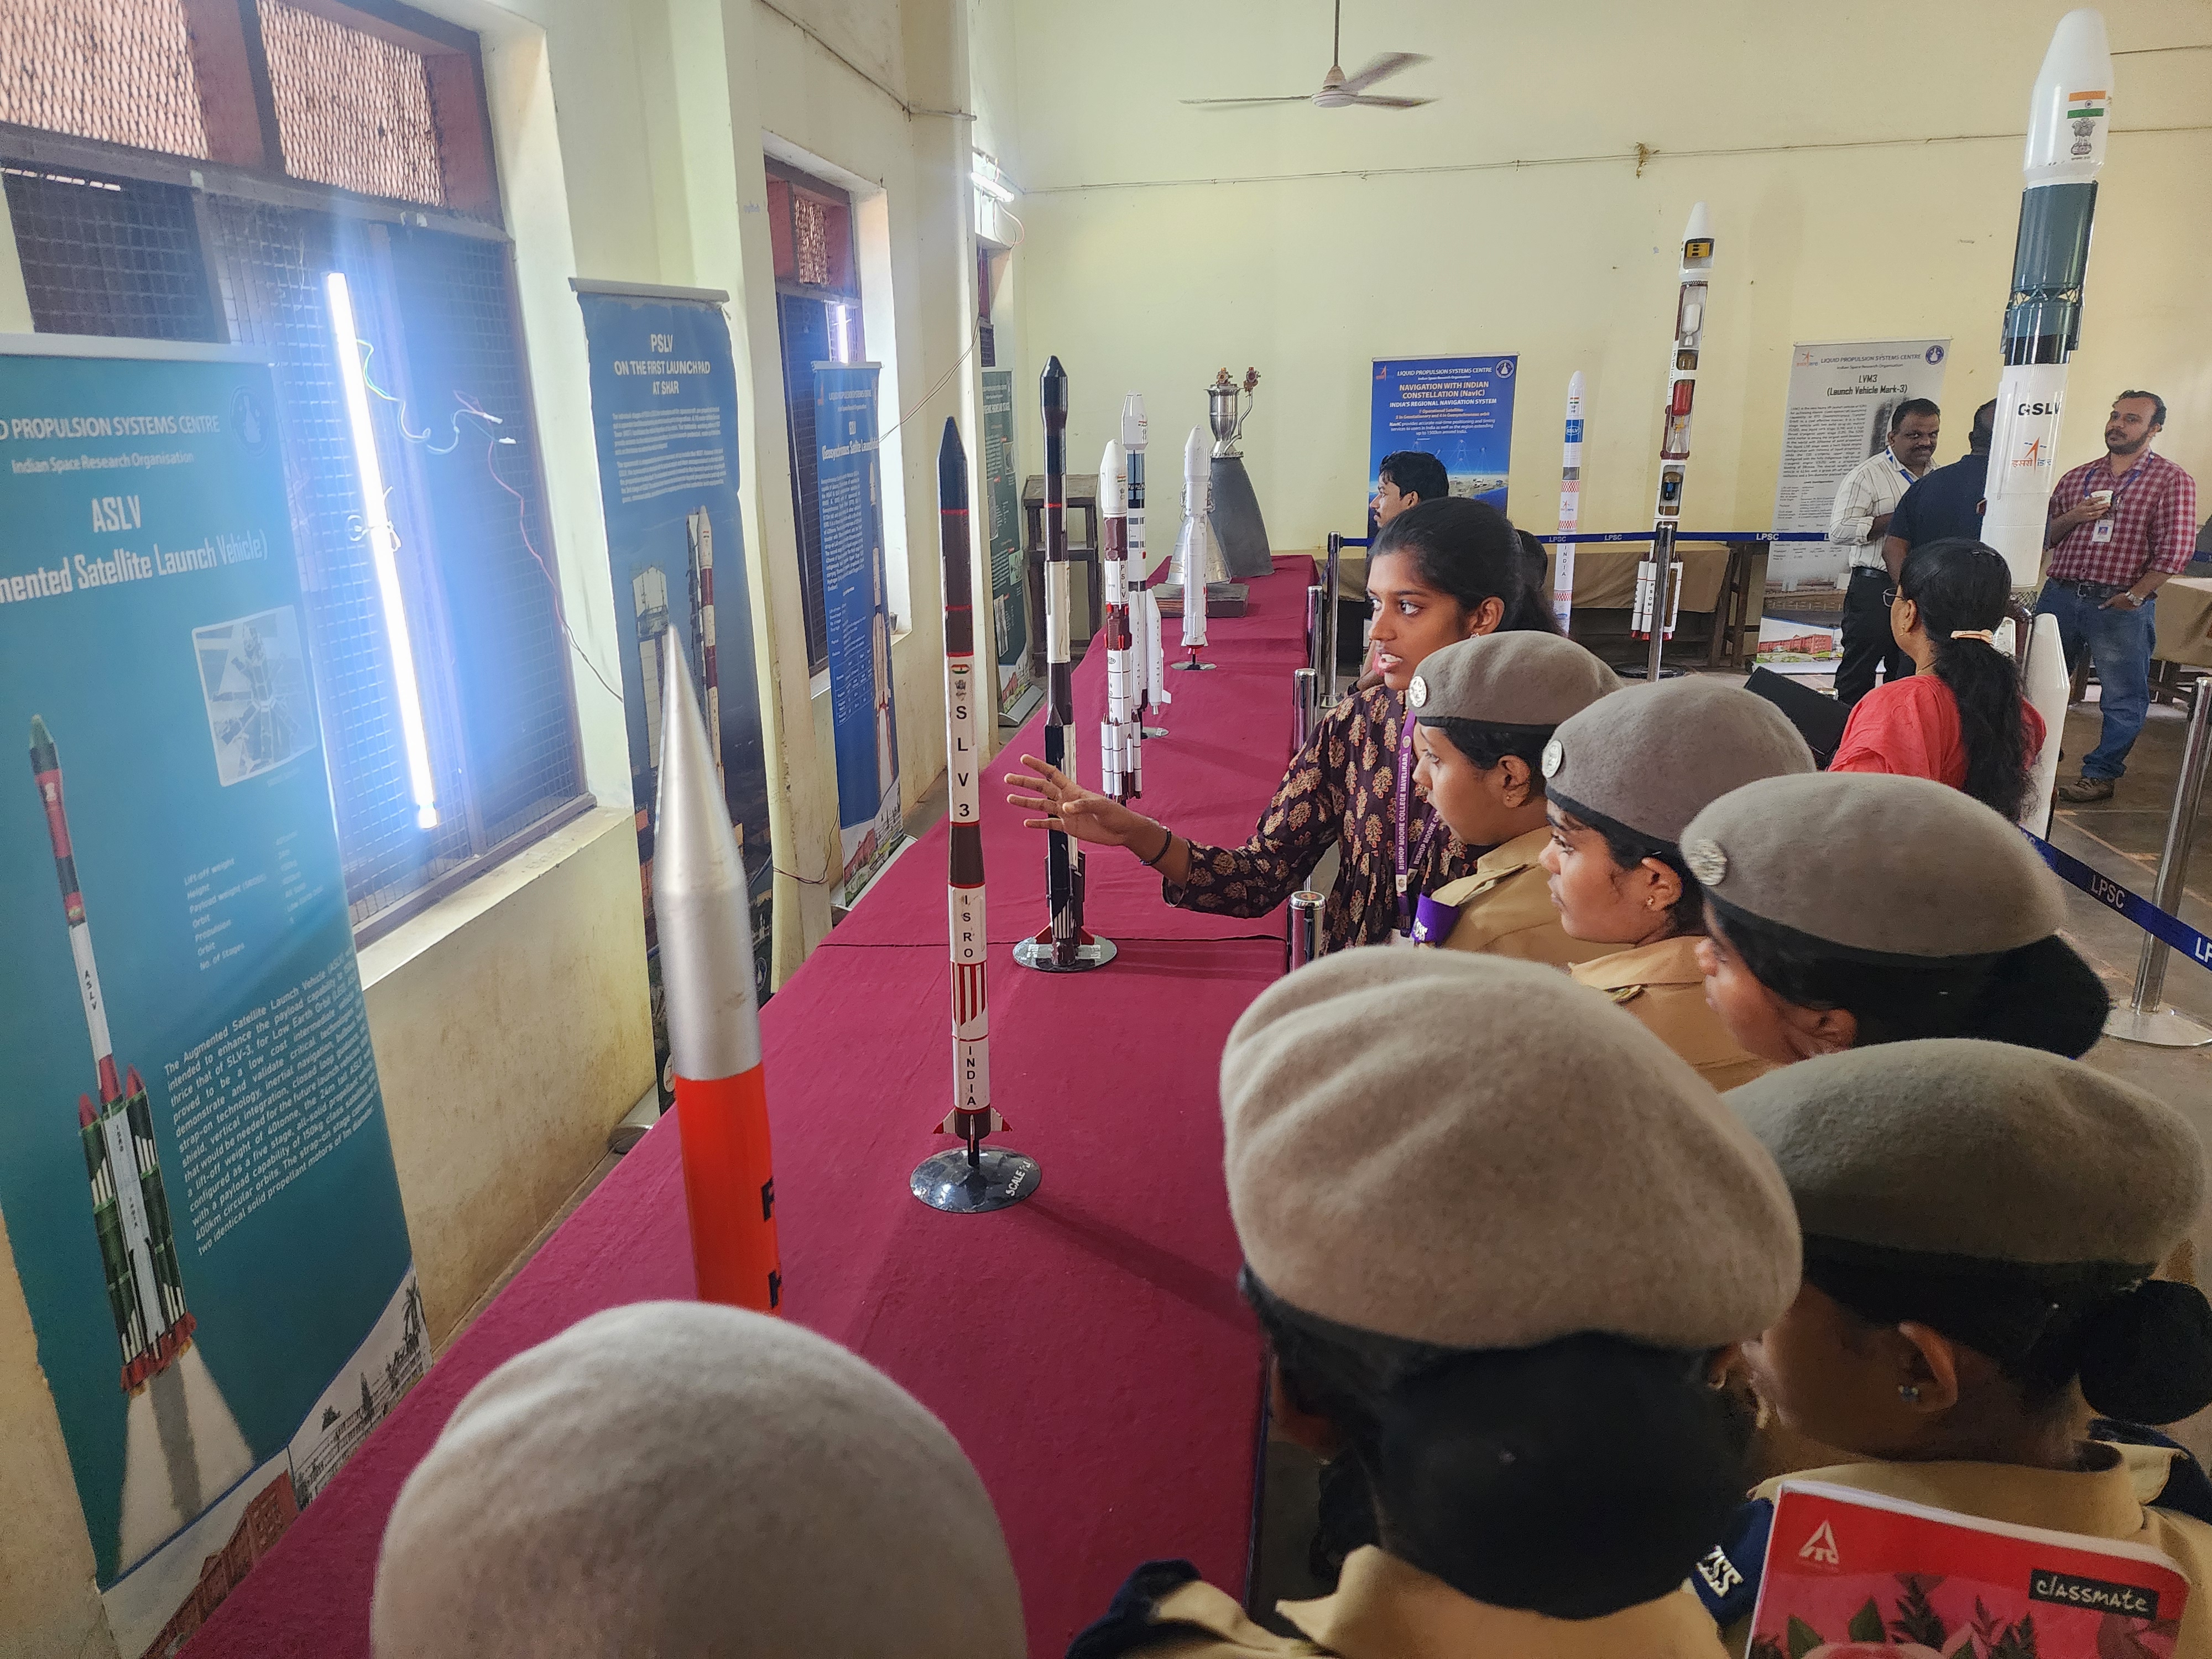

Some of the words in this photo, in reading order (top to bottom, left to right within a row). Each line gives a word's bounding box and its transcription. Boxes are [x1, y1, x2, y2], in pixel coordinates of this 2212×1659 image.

[650, 333, 673, 352] PSLV
[614, 361, 629, 375] ON
[630, 361, 647, 375] THE
[647, 361, 665, 375] FIRST
[666, 361, 698, 374] LAUNCH
[653, 381, 660, 395] AT
[661, 380, 679, 394] SHAR
[1399, 382, 1442, 391] NAVIGATION
[1826, 386, 1853, 396] (Launch
[1854, 385, 1879, 395] Vehicle
[1880, 383, 1908, 395] Mark-3)
[1858, 374, 1877, 383] LVM3
[1402, 390, 1458, 400] CONSTELLATION
[1460, 389, 1485, 397] (NavIC)
[12, 417, 111, 439] PROPULSION
[113, 416, 177, 435] SYSTEMS
[179, 415, 220, 434] CENTRE
[11, 458, 49, 474] Indian
[50, 456, 80, 474] Space
[81, 453, 131, 469] Research
[131, 451, 194, 469] Organisation
[91, 495, 142, 533] ASLV
[74, 548, 153, 589] Satellite
[154, 538, 217, 576] Launch
[216, 529, 268, 565] Vehicle)
[1400, 753, 1408, 791] MAVELIKARA
[1413, 844, 1427, 865] BISHOP
[1425, 822, 1437, 844] MOORE
[187, 883, 210, 900] Height
[2091, 874, 2125, 909] LPSC
[192, 914, 210, 928] Orbit
[963, 894, 974, 958] ISRO
[164, 1060, 179, 1076] The
[184, 1026, 228, 1062] Augmented
[232, 1006, 266, 1031] Satellite
[270, 987, 299, 1010] Launch
[167, 1061, 201, 1091] intended
[204, 1054, 213, 1065] to
[217, 1030, 251, 1056] enhance
[255, 1020, 269, 1033] the
[274, 998, 304, 1025] payload
[170, 1084, 192, 1107] thrice
[196, 1070, 212, 1088] that
[215, 1061, 223, 1075] of
[226, 1044, 253, 1067] SLV-3,
[256, 1035, 269, 1049] for
[272, 1024, 289, 1040] Low
[292, 1009, 313, 1028] Earth
[966, 1046, 977, 1105] INDIA
[173, 1094, 200, 1124] proved
[205, 1087, 214, 1098] to
[220, 1076, 230, 1088] be
[248, 1055, 264, 1070] low
[270, 1039, 288, 1056] cost
[176, 1096, 225, 1137] demonstrate
[232, 1079, 246, 1097] and
[252, 1058, 284, 1082] validate
[290, 1036, 316, 1059] critical
[179, 1121, 213, 1152] strap-on
[216, 1088, 262, 1123] technology,
[265, 1065, 294, 1090] inertial
[182, 1142, 207, 1167] shield,
[210, 1115, 240, 1144] vertical
[243, 1087, 289, 1120] integration,
[292, 1065, 317, 1088] closed
[319, 1054, 334, 1070] loop
[184, 1164, 199, 1182] that
[200, 1144, 223, 1168] would
[225, 1137, 234, 1150] be
[236, 1114, 265, 1141] needed
[266, 1107, 278, 1120] for
[279, 1098, 292, 1112] the
[293, 1082, 316, 1103] future
[195, 1162, 220, 1190] lift-off
[224, 1140, 251, 1166] weight
[254, 1130, 263, 1144] of
[268, 1109, 300, 1134] 40tonne,
[304, 1097, 316, 1110] the
[319, 1083, 335, 1099] 24m
[190, 1171, 229, 1212] configured
[233, 1164, 242, 1177] as
[253, 1145, 268, 1161] five
[270, 1129, 294, 1149] stage,
[296, 1102, 327, 1130] all-solid
[192, 1207, 209, 1227] with
[220, 1172, 249, 1206] payload
[252, 1145, 289, 1177] capability
[292, 1135, 300, 1148] of
[302, 1121, 324, 1140] 150kg
[326, 1105, 343, 1124] class
[196, 1214, 221, 1240] 400km
[223, 1187, 253, 1216] circular
[255, 1168, 280, 1191] orbits.
[282, 1155, 297, 1170] The
[299, 1130, 331, 1158] strap-on
[198, 1238, 212, 1256] two
[213, 1208, 246, 1241] identical
[247, 1191, 265, 1213] solid
[268, 1162, 306, 1199] propellant
[307, 1142, 333, 1167] motors
[1005, 1166, 1026, 1197] SCALE
[2036, 1575, 2148, 1612] classmate
